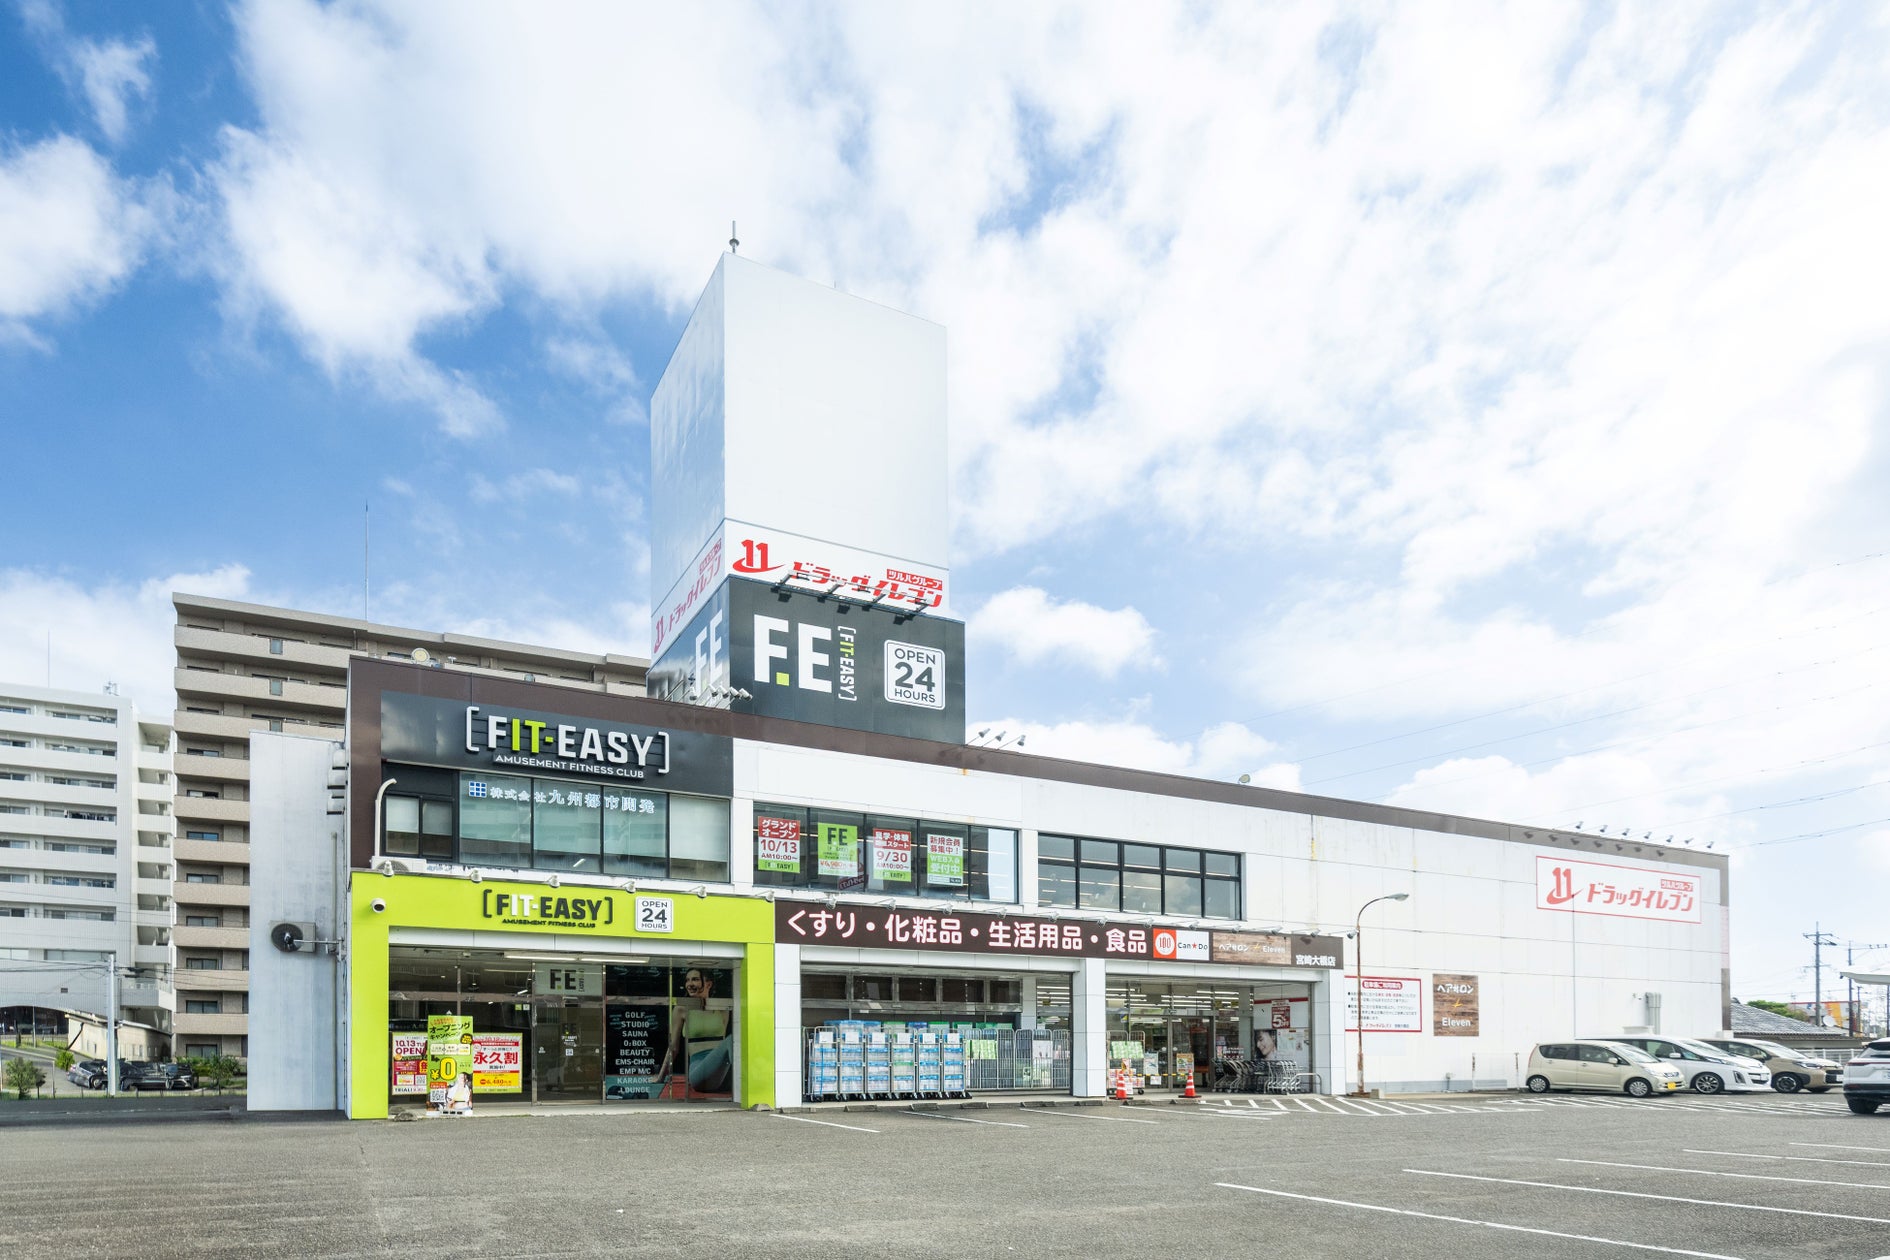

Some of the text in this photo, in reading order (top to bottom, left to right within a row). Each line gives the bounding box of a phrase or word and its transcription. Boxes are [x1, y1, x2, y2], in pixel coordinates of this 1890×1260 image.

[887, 569, 942, 590] ツルハグループ
[895, 648, 935, 664] OPEN
[895, 662, 935, 692] 24
[895, 688, 935, 703] HOURS
[495, 755, 644, 778] AMUSEMENT FITNESS CLUB
[762, 819, 797, 830] グランド
[762, 829, 797, 838] オープン
[760, 839, 797, 853] 10/13
[875, 840, 909, 848] スタート
[877, 850, 908, 862] 9/30
[1587, 883, 1694, 912] ドラッグイレブン
[641, 900, 668, 908] OPEN
[641, 908, 668, 924] 24
[502, 918, 546, 926] AMUSEMENT
[548, 920, 576, 928] FITNESS
[1218, 943, 1249, 953] ヘアサロン
[1437, 983, 1474, 994] ヘアサロン
[625, 1011, 646, 1019] GOLF
[429, 1022, 470, 1034] オープニング
[1441, 1017, 1471, 1027] Eleven
[473, 1051, 518, 1064] 永久割
